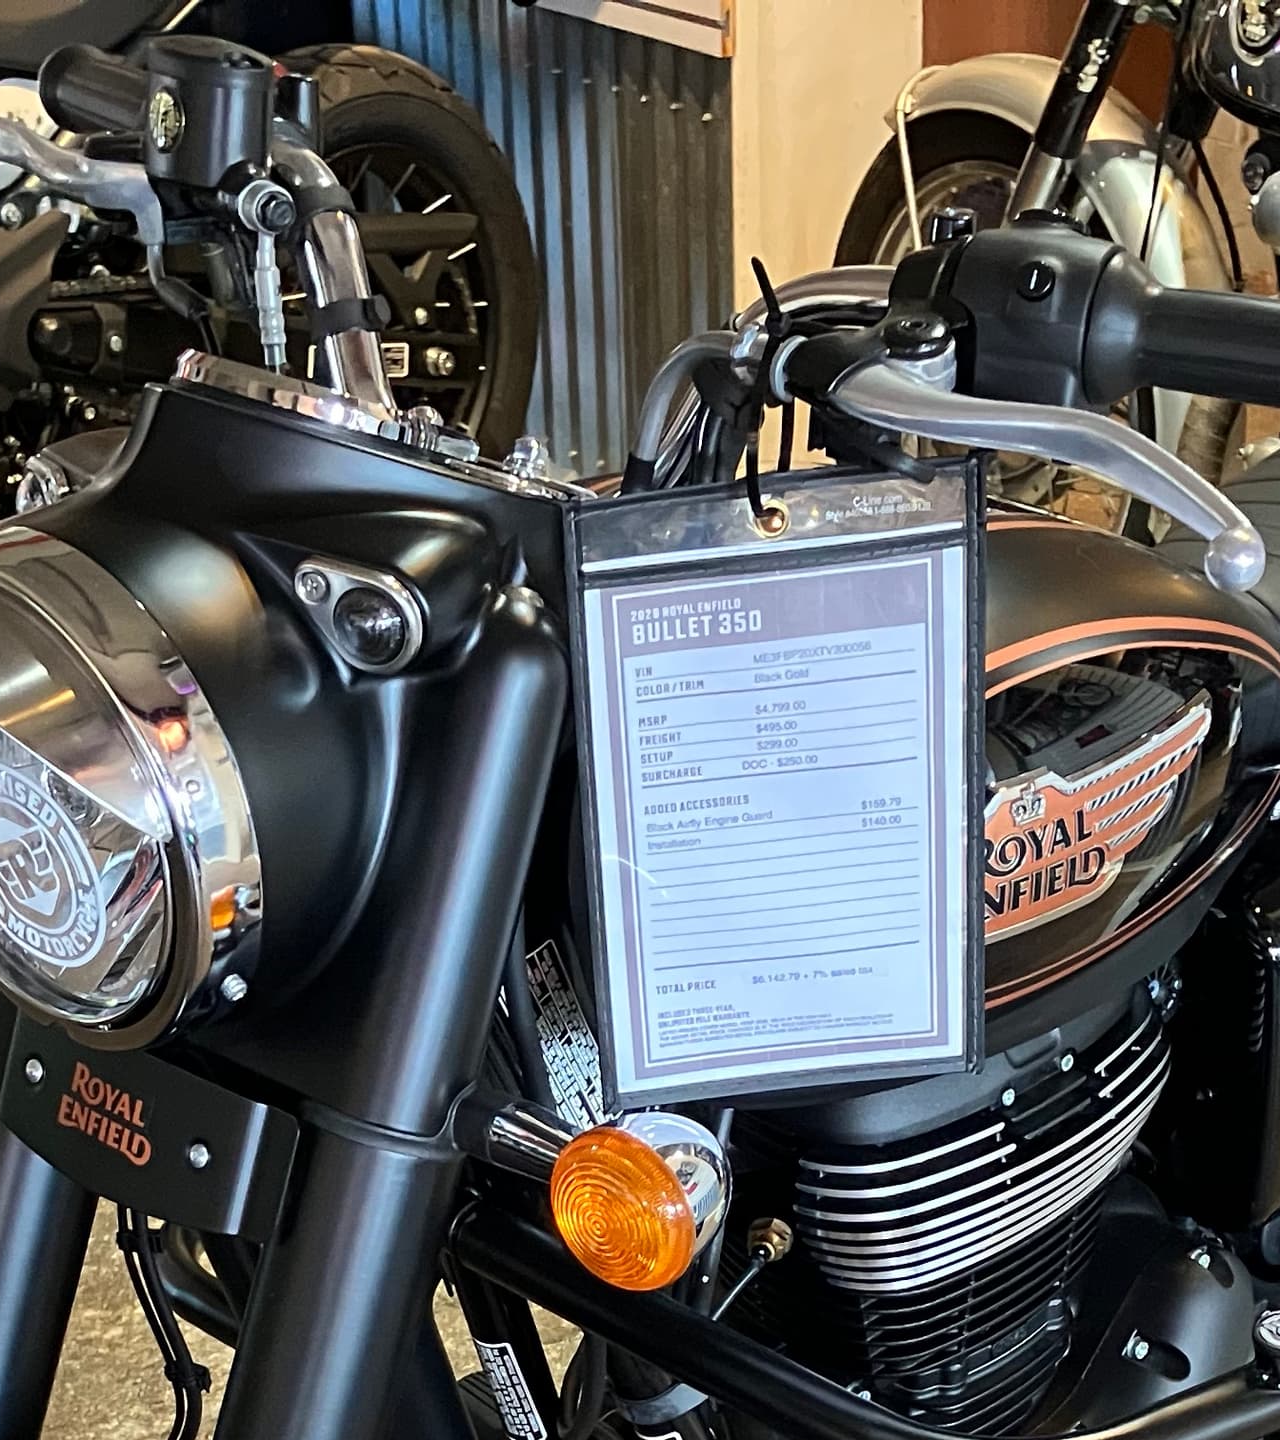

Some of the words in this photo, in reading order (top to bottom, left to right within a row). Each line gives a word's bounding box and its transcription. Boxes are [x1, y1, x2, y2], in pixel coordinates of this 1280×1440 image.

[662, 603, 696, 618] ROYAL
[697, 598, 741, 613] ENFIELD
[632, 615, 713, 645] BULLET
[718, 609, 762, 634] 350
[635, 666, 653, 678] VIN
[754, 671, 782, 684] Black
[784, 667, 809, 681] Gold
[638, 715, 667, 728] MSRP
[640, 732, 681, 746] FREIGHT
[641, 751, 673, 765] SETUP
[642, 766, 702, 783] SURCHARGE
[742, 759, 768, 770] DOC
[644, 802, 677, 816] ADDED
[680, 794, 750, 812] ACCESSORIES
[985, 846, 1107, 918] NFIELD
[656, 983, 685, 995] TOTAL
[687, 980, 717, 991] PRICE
[72, 1061, 145, 1128] ROYAL
[57, 1093, 152, 1166] ENFIELD
